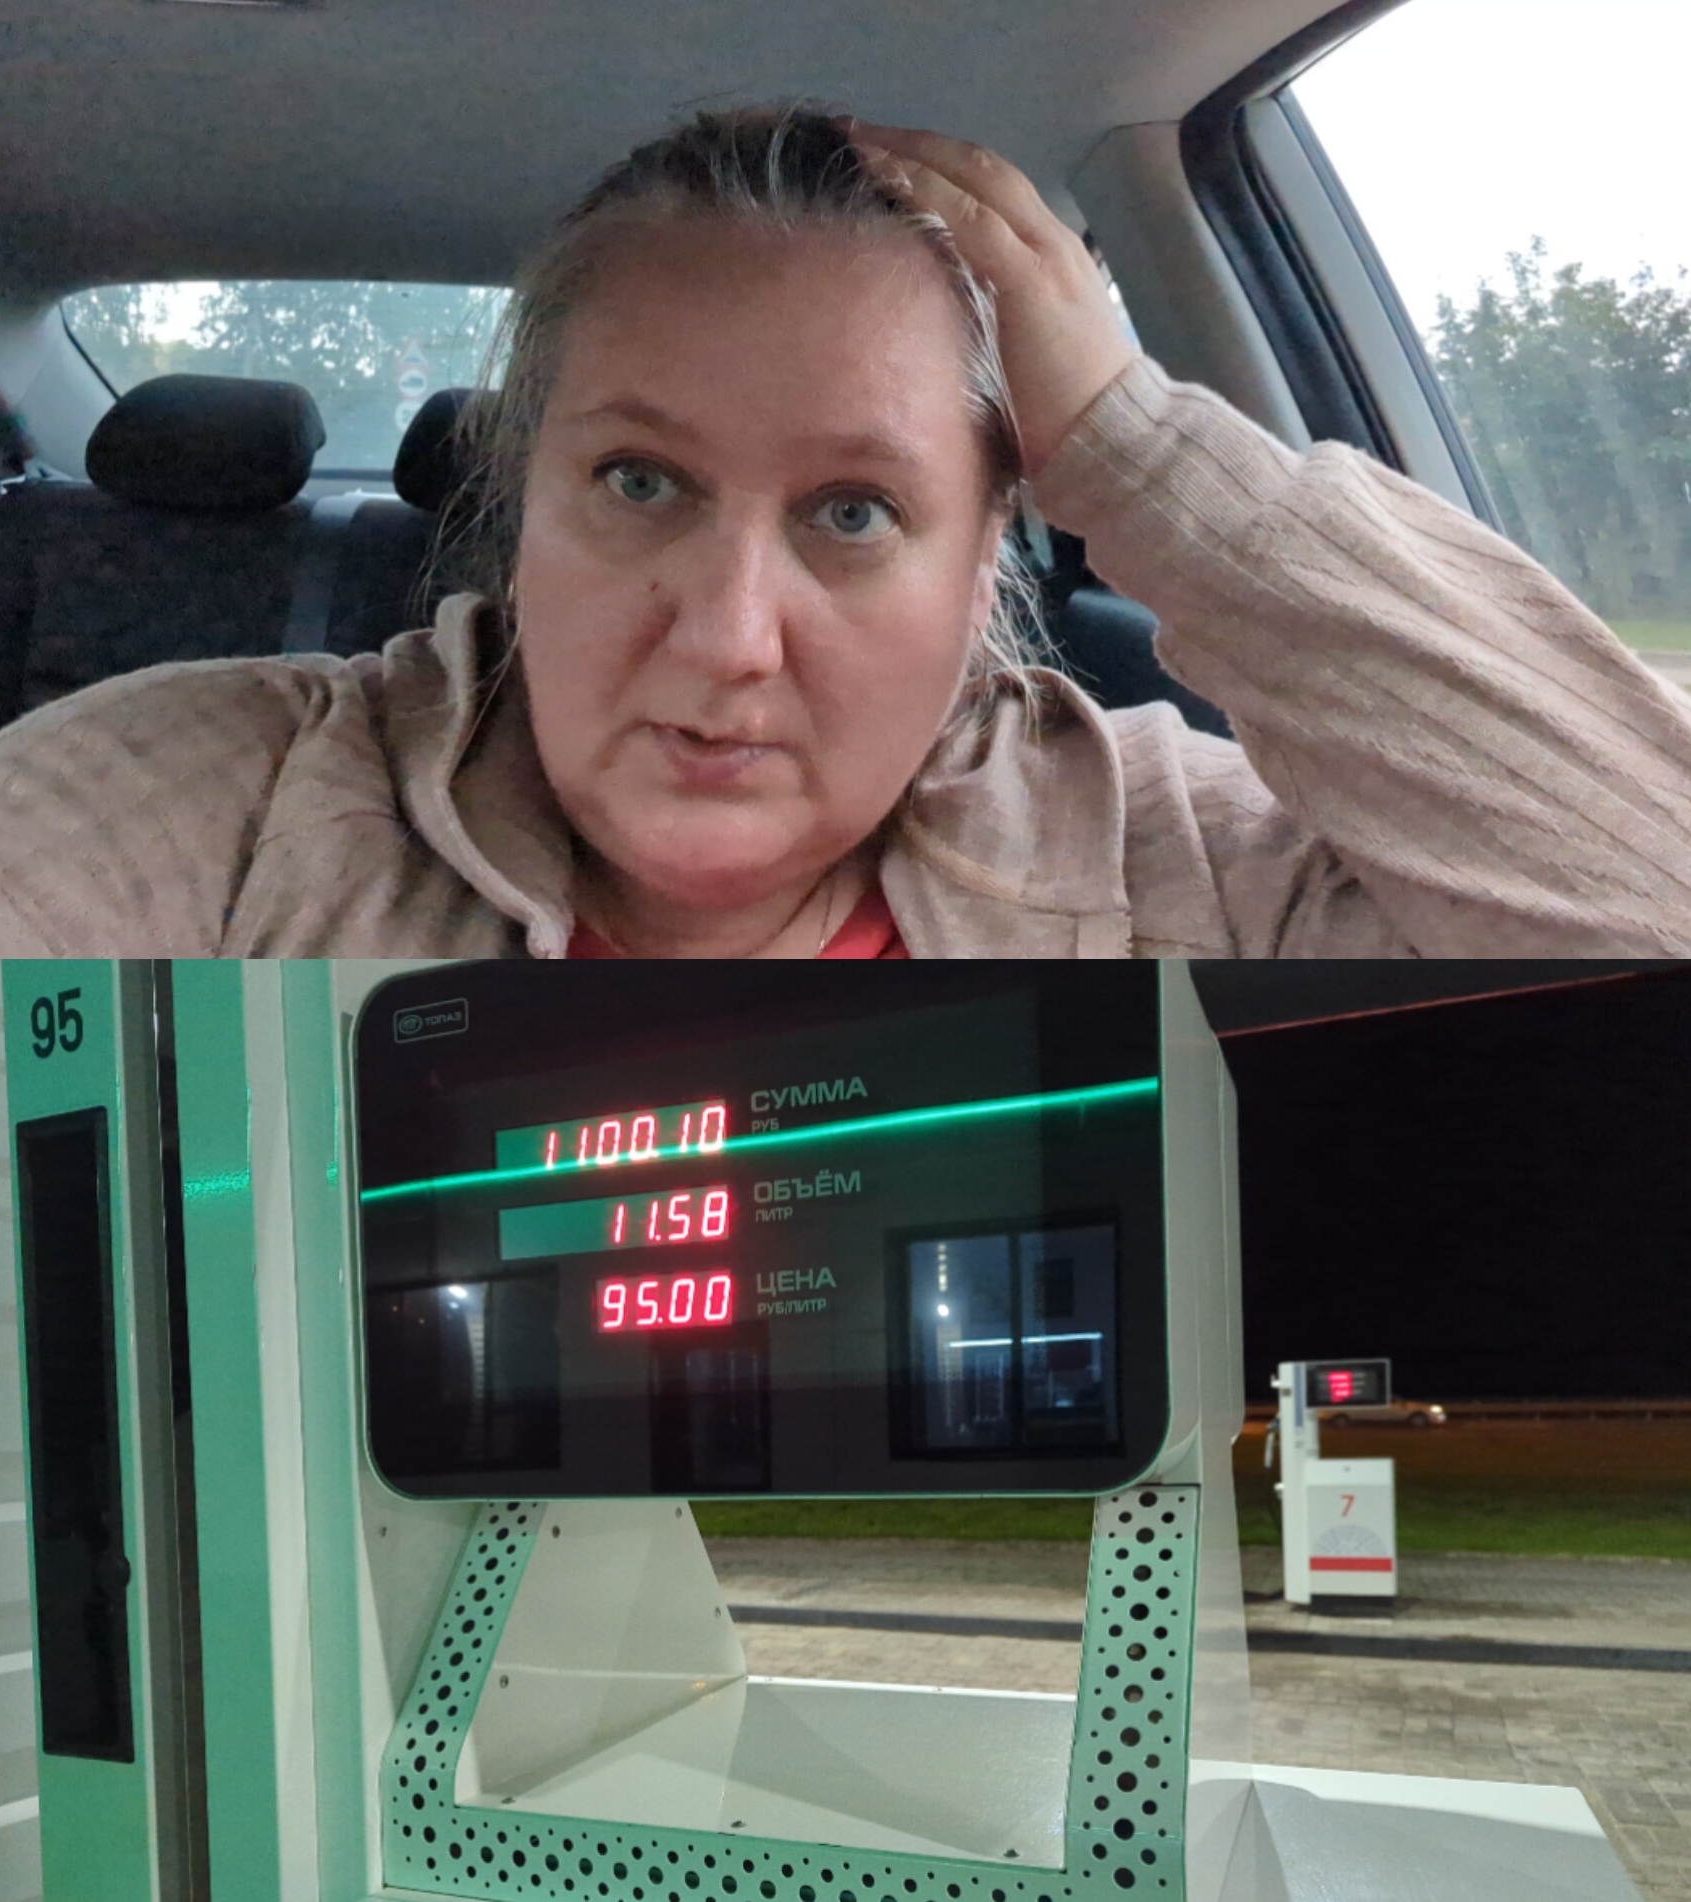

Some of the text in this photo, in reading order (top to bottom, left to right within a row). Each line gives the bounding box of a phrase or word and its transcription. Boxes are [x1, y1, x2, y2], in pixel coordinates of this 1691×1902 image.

[30, 986, 83, 1059] 95
[750, 1076, 869, 1112] СУММА
[751, 1118, 780, 1134] РУБ
[753, 1169, 861, 1203] ОБЪЁМ
[614, 1190, 728, 1243] 11.58
[756, 1267, 837, 1298] ЦЕНА
[602, 1274, 732, 1328] 95.00
[1340, 1494, 1355, 1518] 7
